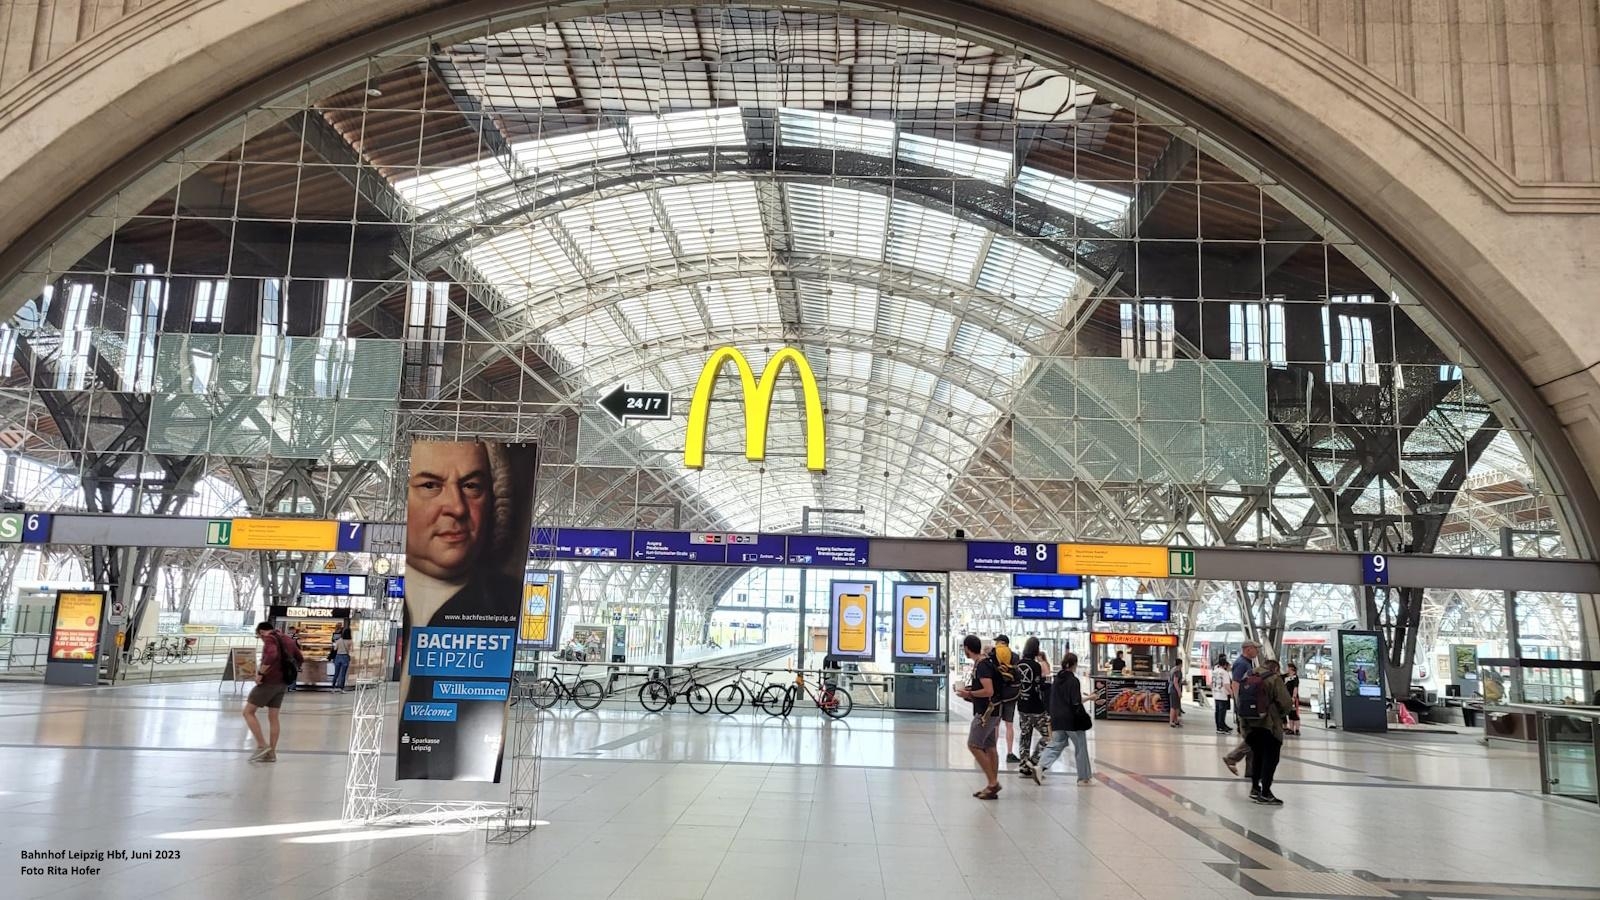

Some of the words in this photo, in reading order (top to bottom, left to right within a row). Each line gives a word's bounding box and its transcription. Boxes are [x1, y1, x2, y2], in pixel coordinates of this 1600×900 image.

[684, 346, 825, 472] M
[0, 517, 17, 538] S
[27, 514, 39, 531] 6
[349, 522, 361, 539] 7
[1014, 545, 1027, 556] 8a
[1036, 543, 1047, 561] 8
[1373, 554, 1385, 573] 9
[444, 614, 516, 623] www.bachfestleipzig.de
[417, 633, 510, 650] BACHFEST
[416, 652, 484, 668] LEIPZIG
[438, 683, 506, 696] Willkommen
[411, 705, 452, 716] Welcome
[411, 737, 441, 745] Sparkasse
